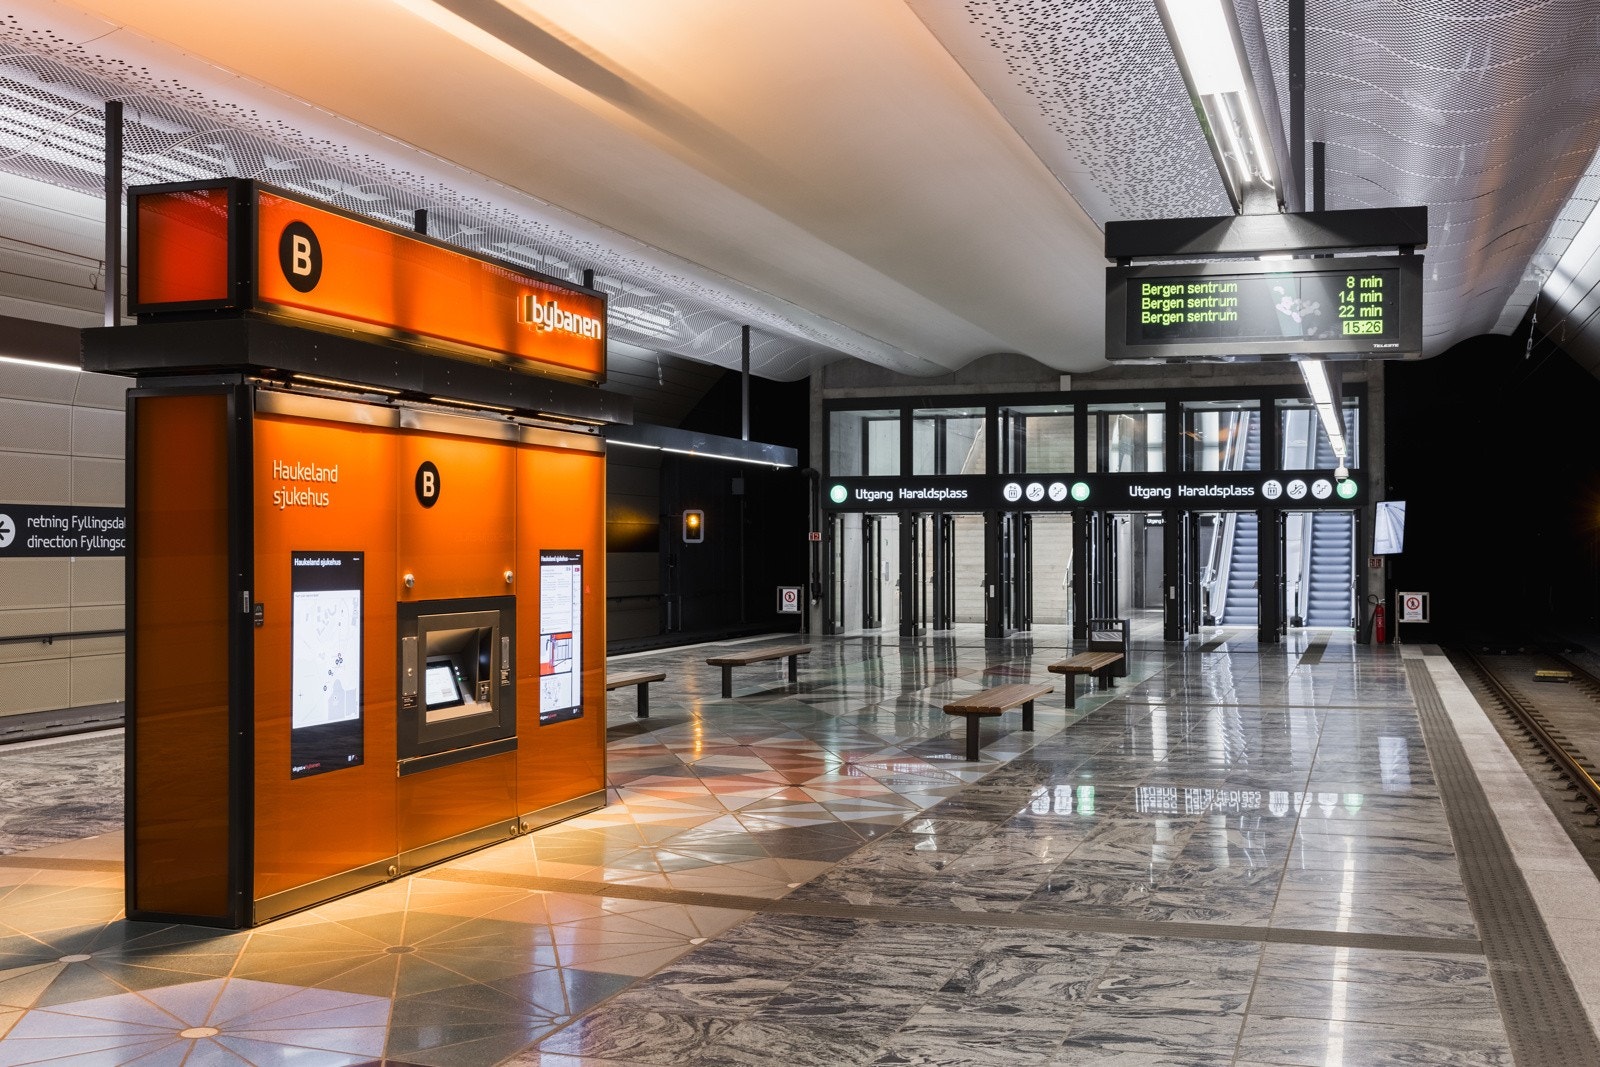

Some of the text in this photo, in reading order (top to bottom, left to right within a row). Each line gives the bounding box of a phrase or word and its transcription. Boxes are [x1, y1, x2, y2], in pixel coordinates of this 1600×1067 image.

[292, 234, 312, 276] B
[1142, 275, 1382, 298] Bergen sentrum 8 min
[1142, 290, 1382, 312] Bergen sentrum 14 min
[531, 294, 602, 340] bybanen
[1142, 304, 1382, 326] Bergen sentrum 22 min
[1344, 321, 1381, 333] 15:26
[273, 460, 338, 483] Haukeland
[423, 471, 435, 498] B
[855, 488, 968, 502] Utgang Haraldsplass
[1129, 485, 1255, 499] Utgang Haraldsplass
[273, 486, 330, 509] sjukehus
[27, 515, 69, 532] retning
[27, 535, 78, 548] direction
